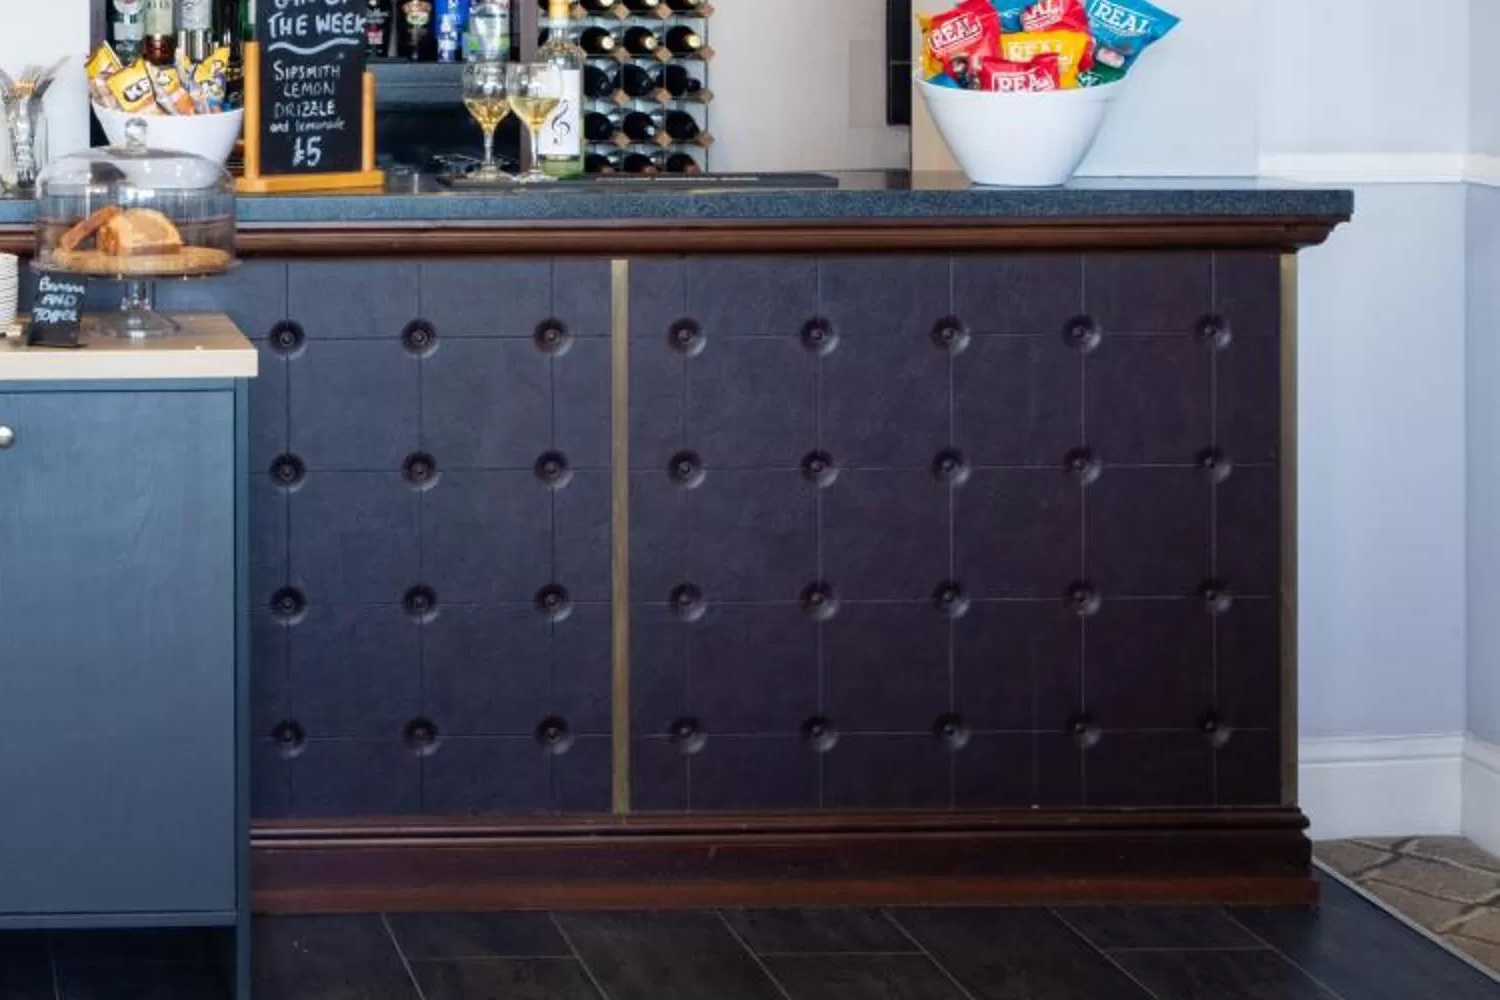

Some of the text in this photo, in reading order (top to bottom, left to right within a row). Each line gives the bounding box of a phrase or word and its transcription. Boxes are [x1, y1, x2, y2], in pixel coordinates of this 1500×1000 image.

[268, 12, 308, 39] THE
[316, 12, 366, 34] WEEK
[1094, 0, 1153, 35] REAL
[273, 60, 341, 81] SIPSMITH
[283, 82, 336, 98] LEMON
[274, 100, 336, 118] DRIZZLE
[292, 135, 323, 168] £5
